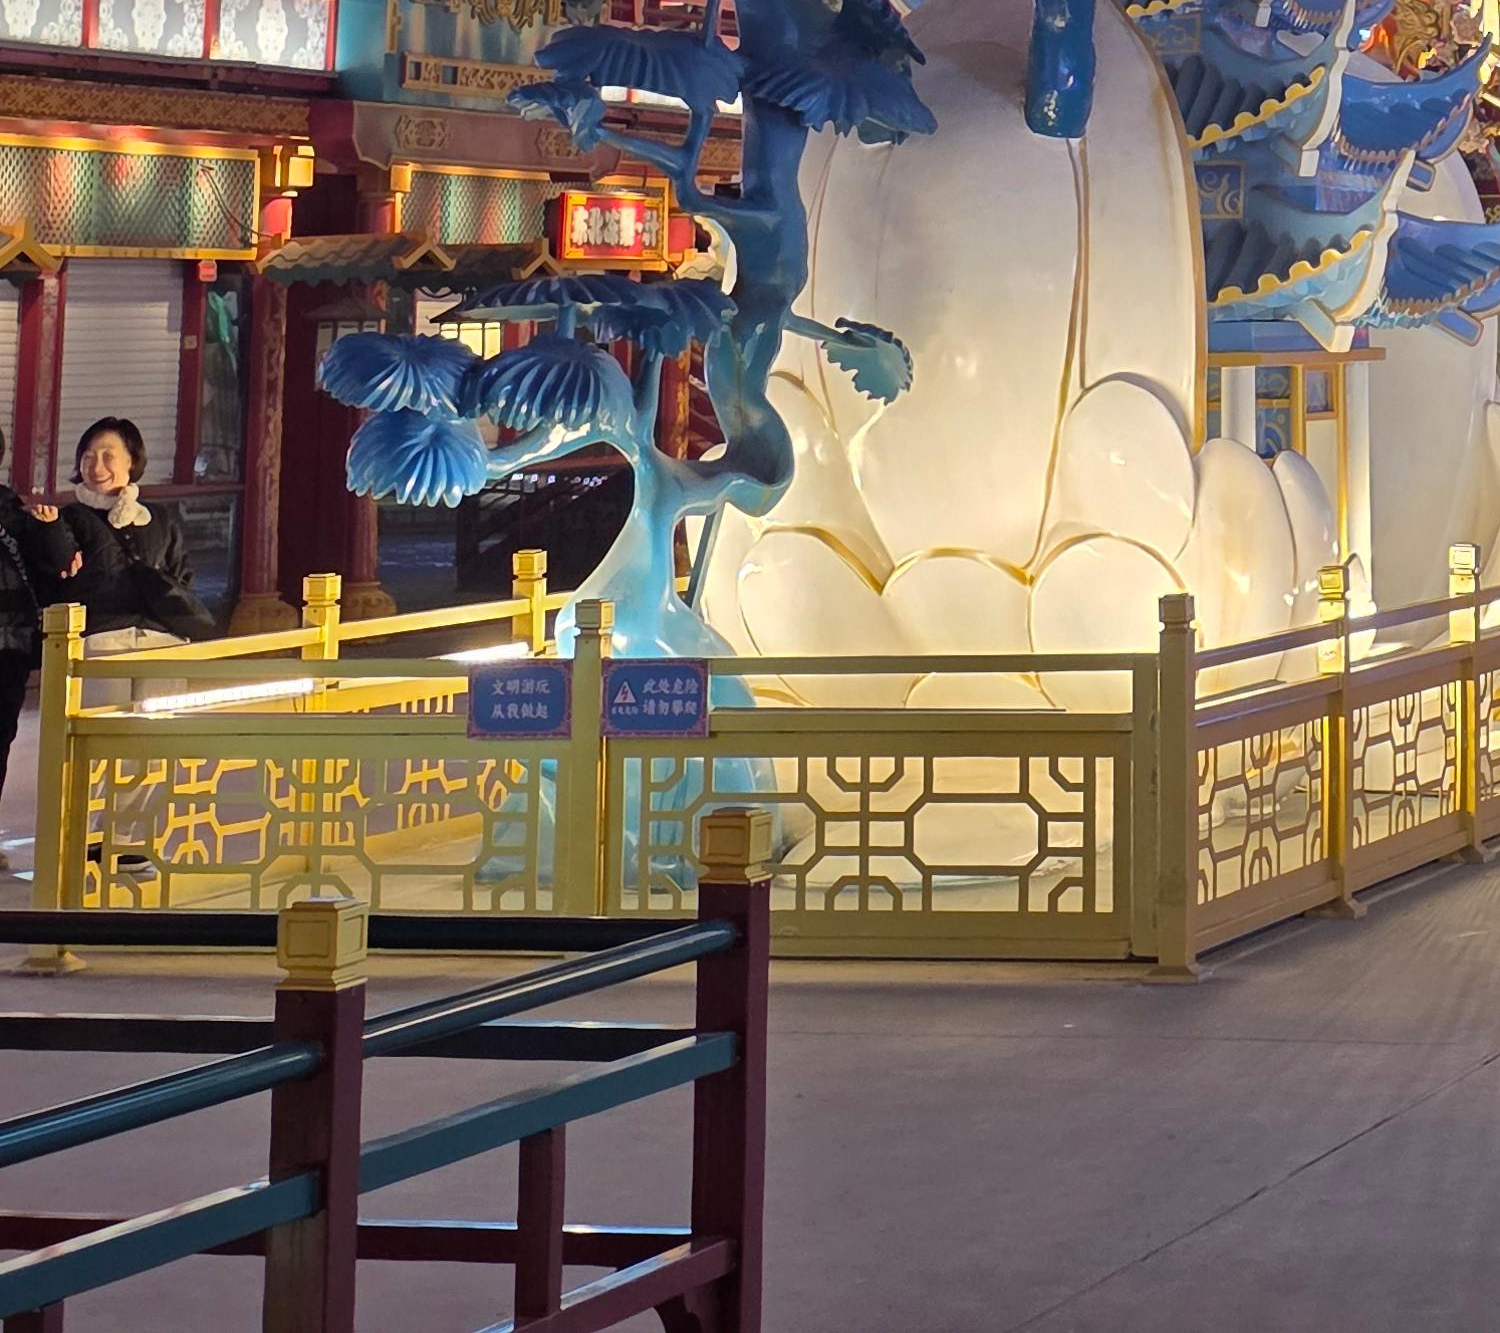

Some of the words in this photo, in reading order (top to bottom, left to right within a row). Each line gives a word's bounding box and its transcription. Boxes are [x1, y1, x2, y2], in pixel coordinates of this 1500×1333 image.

[491, 679, 550, 694] 文明游玩
[642, 678, 698, 694] 此处危险
[490, 701, 549, 719] 从我做起
[642, 699, 698, 716] 请勿攀爬
